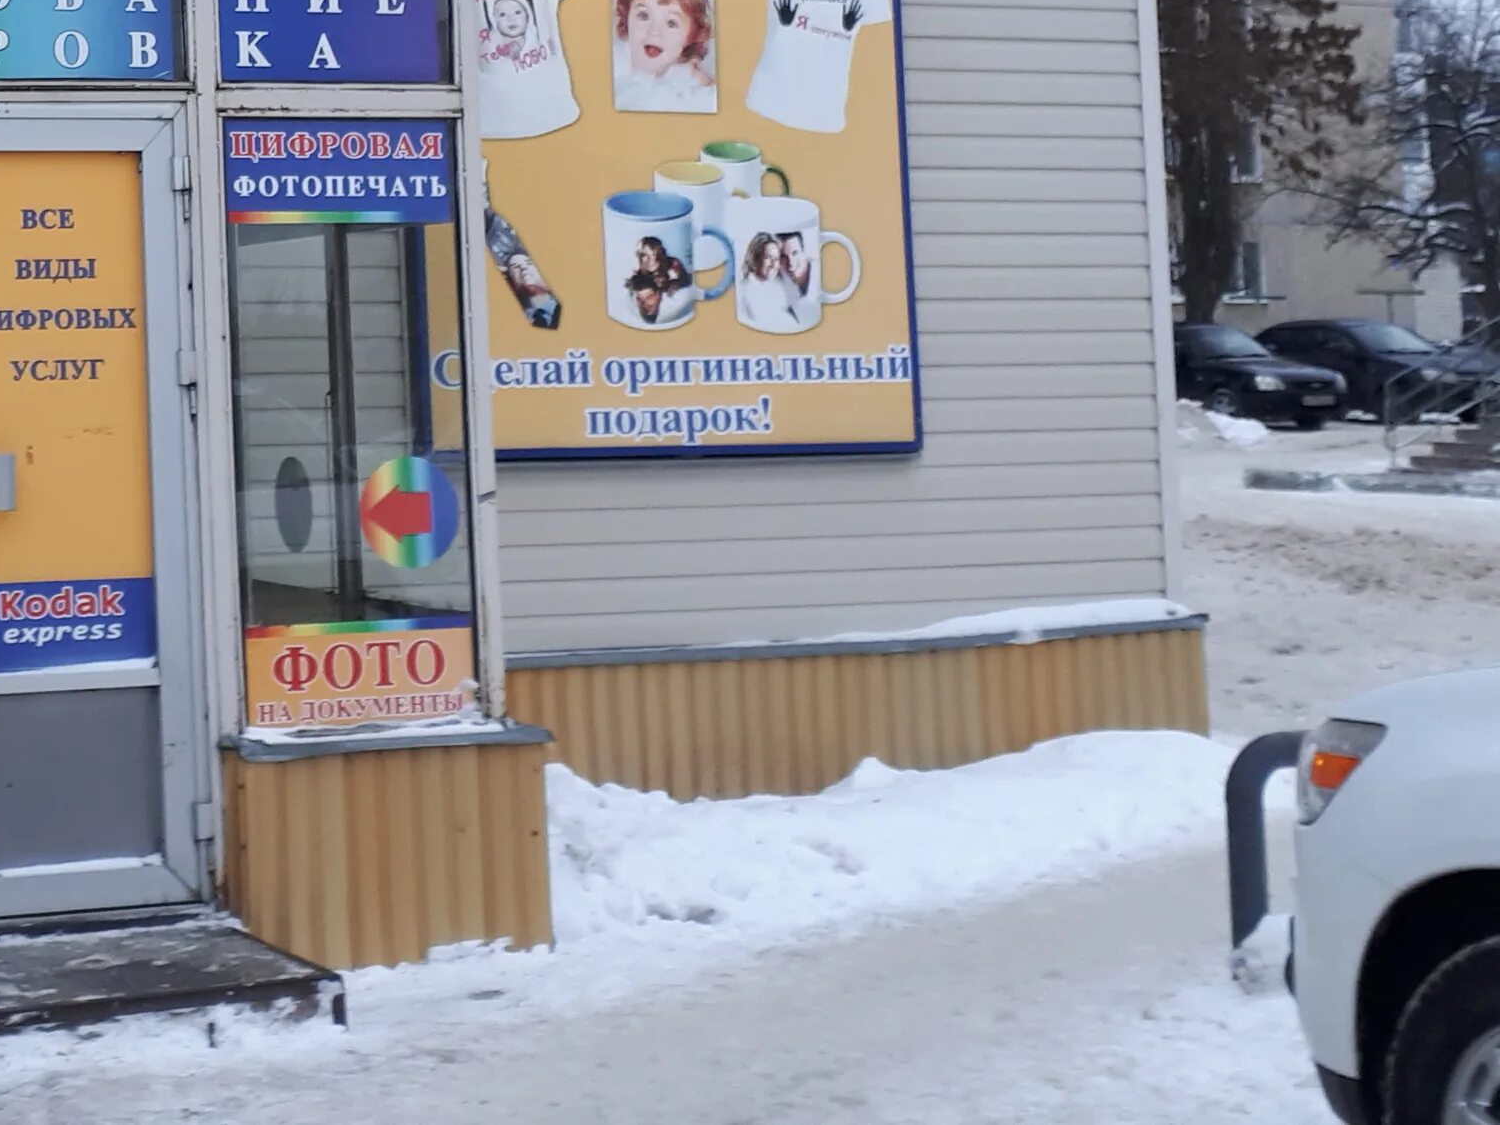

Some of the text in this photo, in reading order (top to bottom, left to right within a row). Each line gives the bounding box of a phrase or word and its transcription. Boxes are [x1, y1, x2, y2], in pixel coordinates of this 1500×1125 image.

[230, 131, 444, 163] ЦИФРОВАЯ
[232, 175, 448, 198] ФОТОПЕЧАТЬ
[19, 208, 76, 231] ВСЕ
[14, 257, 97, 282] ВИДЫ
[9, 357, 105, 383] УСЛУГ
[433, 345, 912, 396] Селай оригинальный
[585, 397, 773, 444] подарок!
[2, 620, 124, 646] express
[271, 637, 447, 693] ФОТО
[257, 691, 465, 725] НА ДОКУМЕНТЫ
